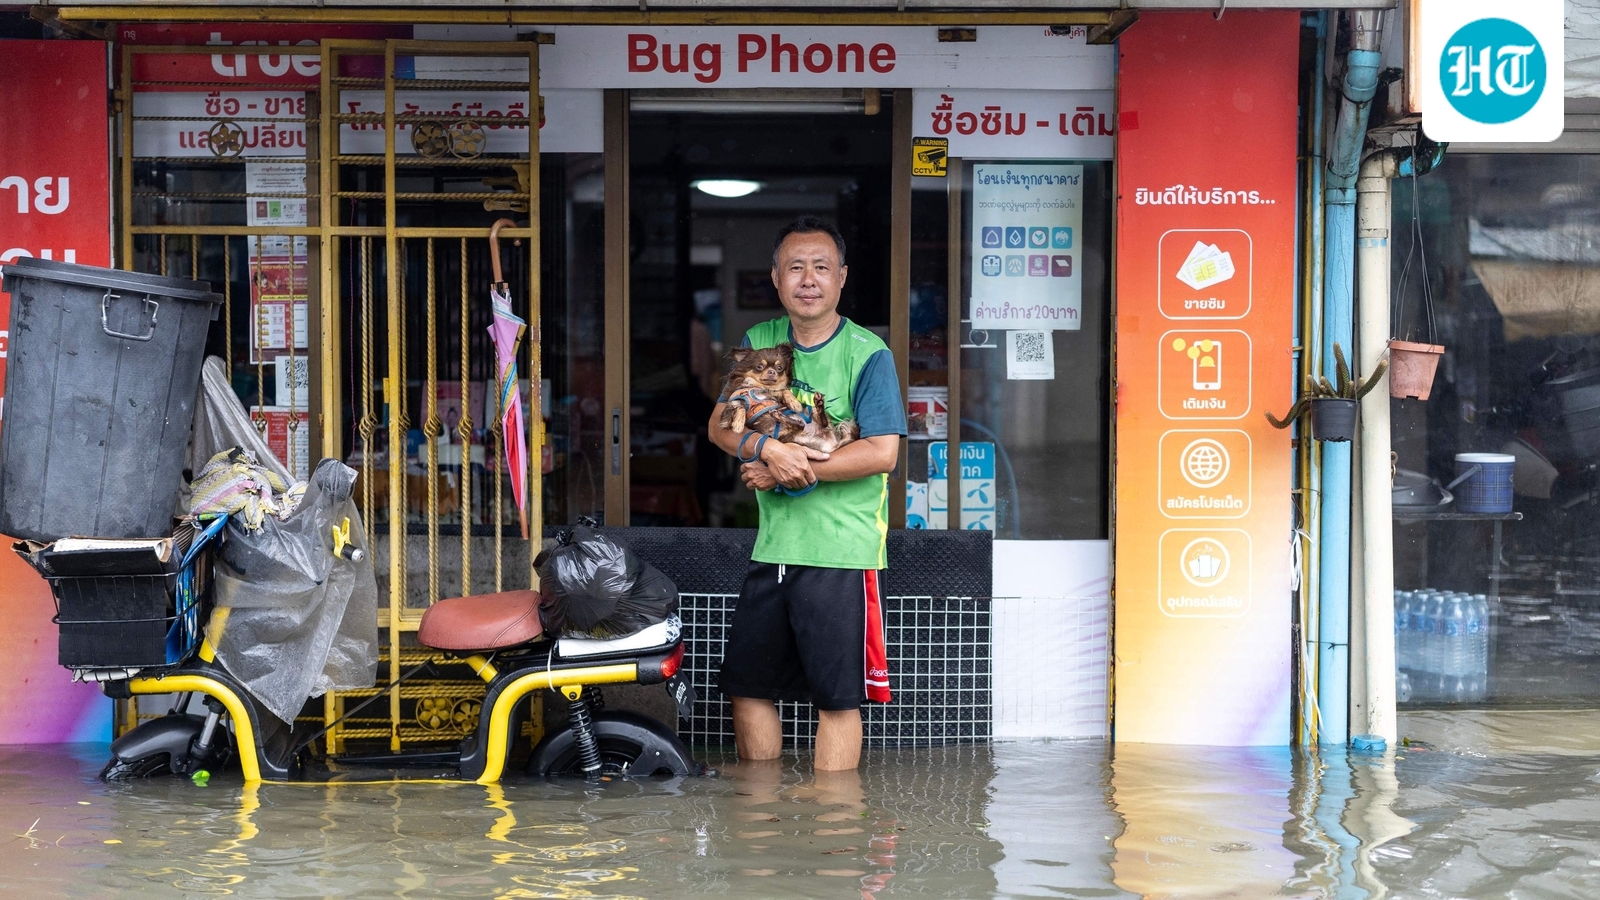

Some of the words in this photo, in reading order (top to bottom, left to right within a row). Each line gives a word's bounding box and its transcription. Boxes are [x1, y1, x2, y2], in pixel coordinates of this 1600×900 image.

[206, 32, 321, 77] true
[628, 34, 720, 83] Bug
[738, 34, 896, 74] Phone
[931, 94, 1026, 136] ซื้อซิม
[1059, 107, 1114, 136] เติม
[920, 139, 948, 147] WARNING
[977, 168, 1081, 190] โอนเงินทุกธนาคาร
[1135, 184, 1276, 205] ยินดีให้บริการ...
[1184, 297, 1226, 310] ขายซิม
[1182, 397, 1227, 410] เติมเงิน
[1166, 494, 1243, 509] สมัครโปรเน็ต
